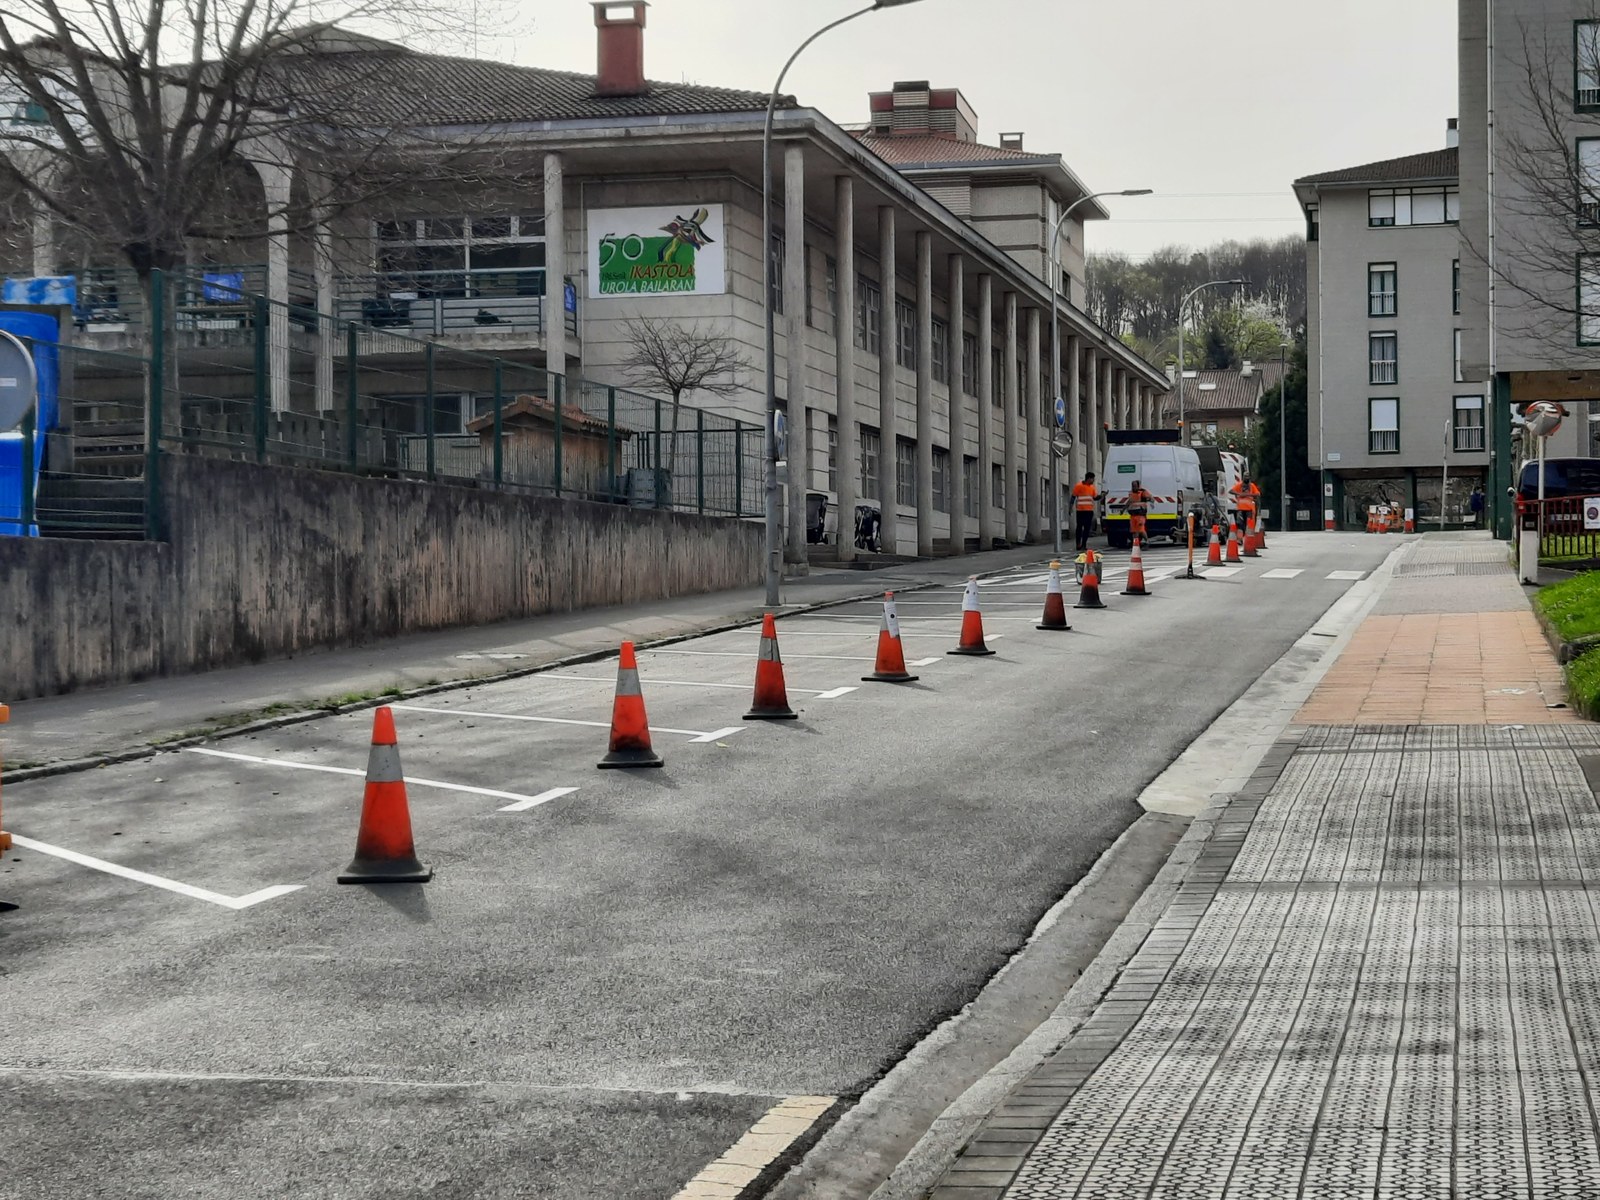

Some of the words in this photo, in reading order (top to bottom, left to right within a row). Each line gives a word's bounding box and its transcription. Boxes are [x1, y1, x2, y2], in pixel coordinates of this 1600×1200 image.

[599, 233, 644, 268] 50
[630, 264, 694, 279] IKASTOLA
[601, 281, 637, 293] UROLA
[640, 279, 694, 292] BAILARAN
